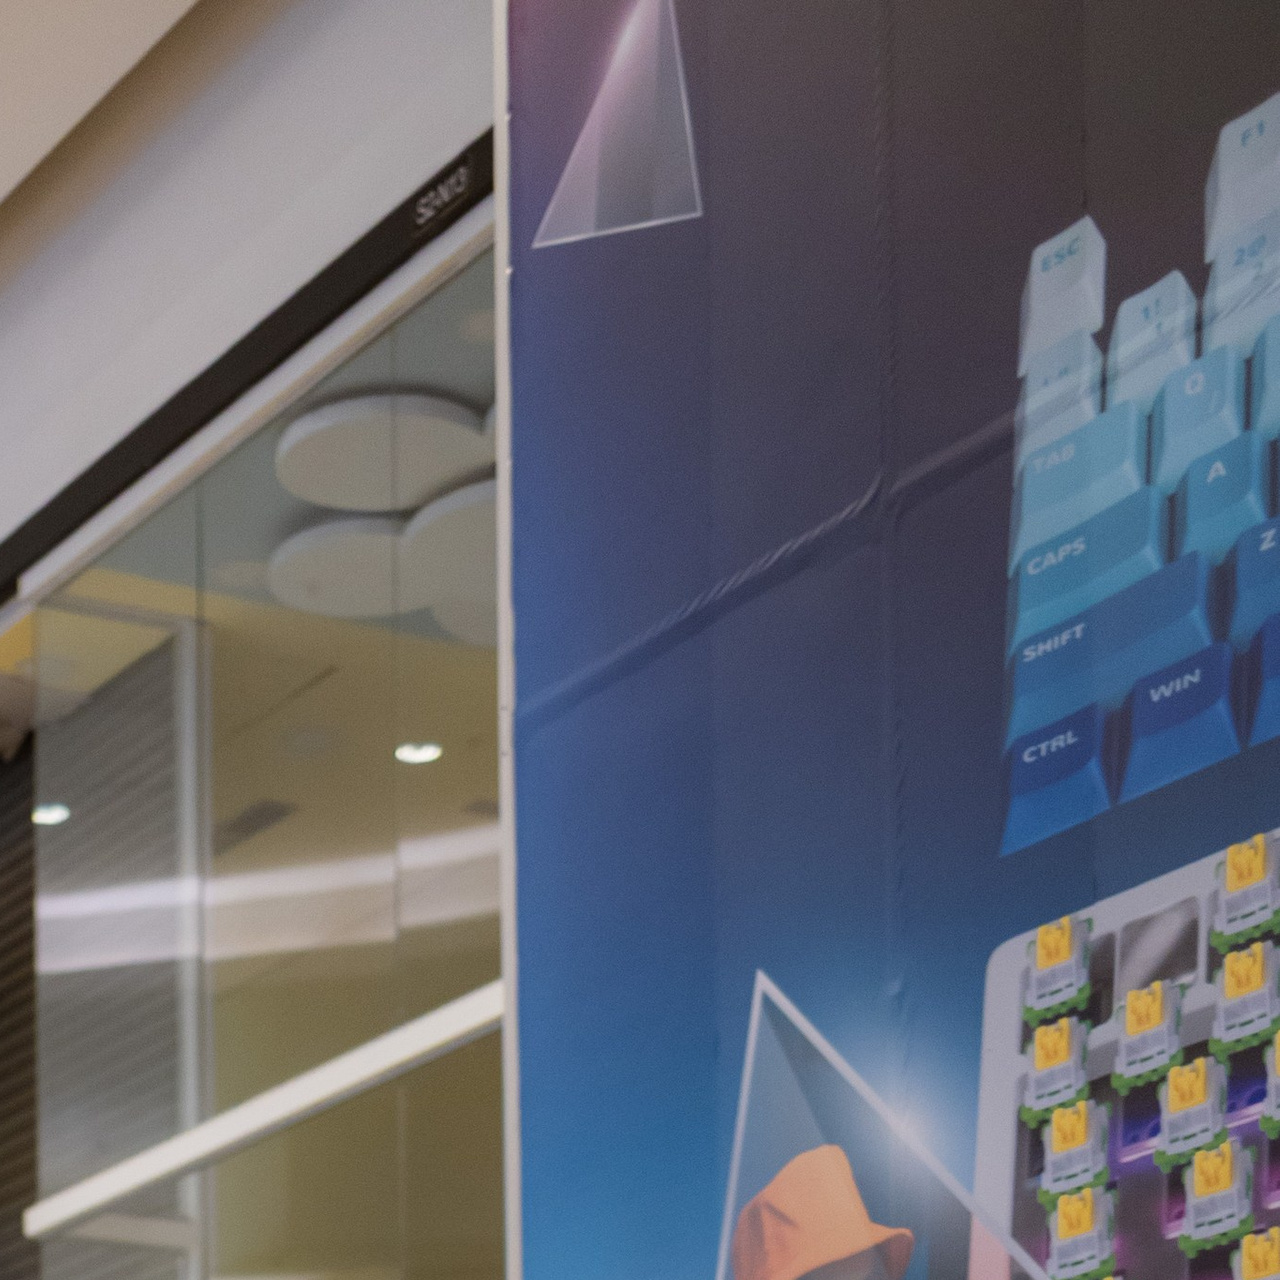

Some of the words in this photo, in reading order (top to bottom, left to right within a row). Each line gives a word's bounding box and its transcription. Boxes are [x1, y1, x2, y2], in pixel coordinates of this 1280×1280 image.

[1041, 237, 1081, 273] ESC
[1206, 460, 1227, 484] A
[1026, 537, 1087, 576] CAPS
[1258, 527, 1277, 552] Z
[1022, 622, 1086, 663] SHIFT
[1149, 667, 1202, 703] WIN
[1022, 730, 1078, 764] CTRL
